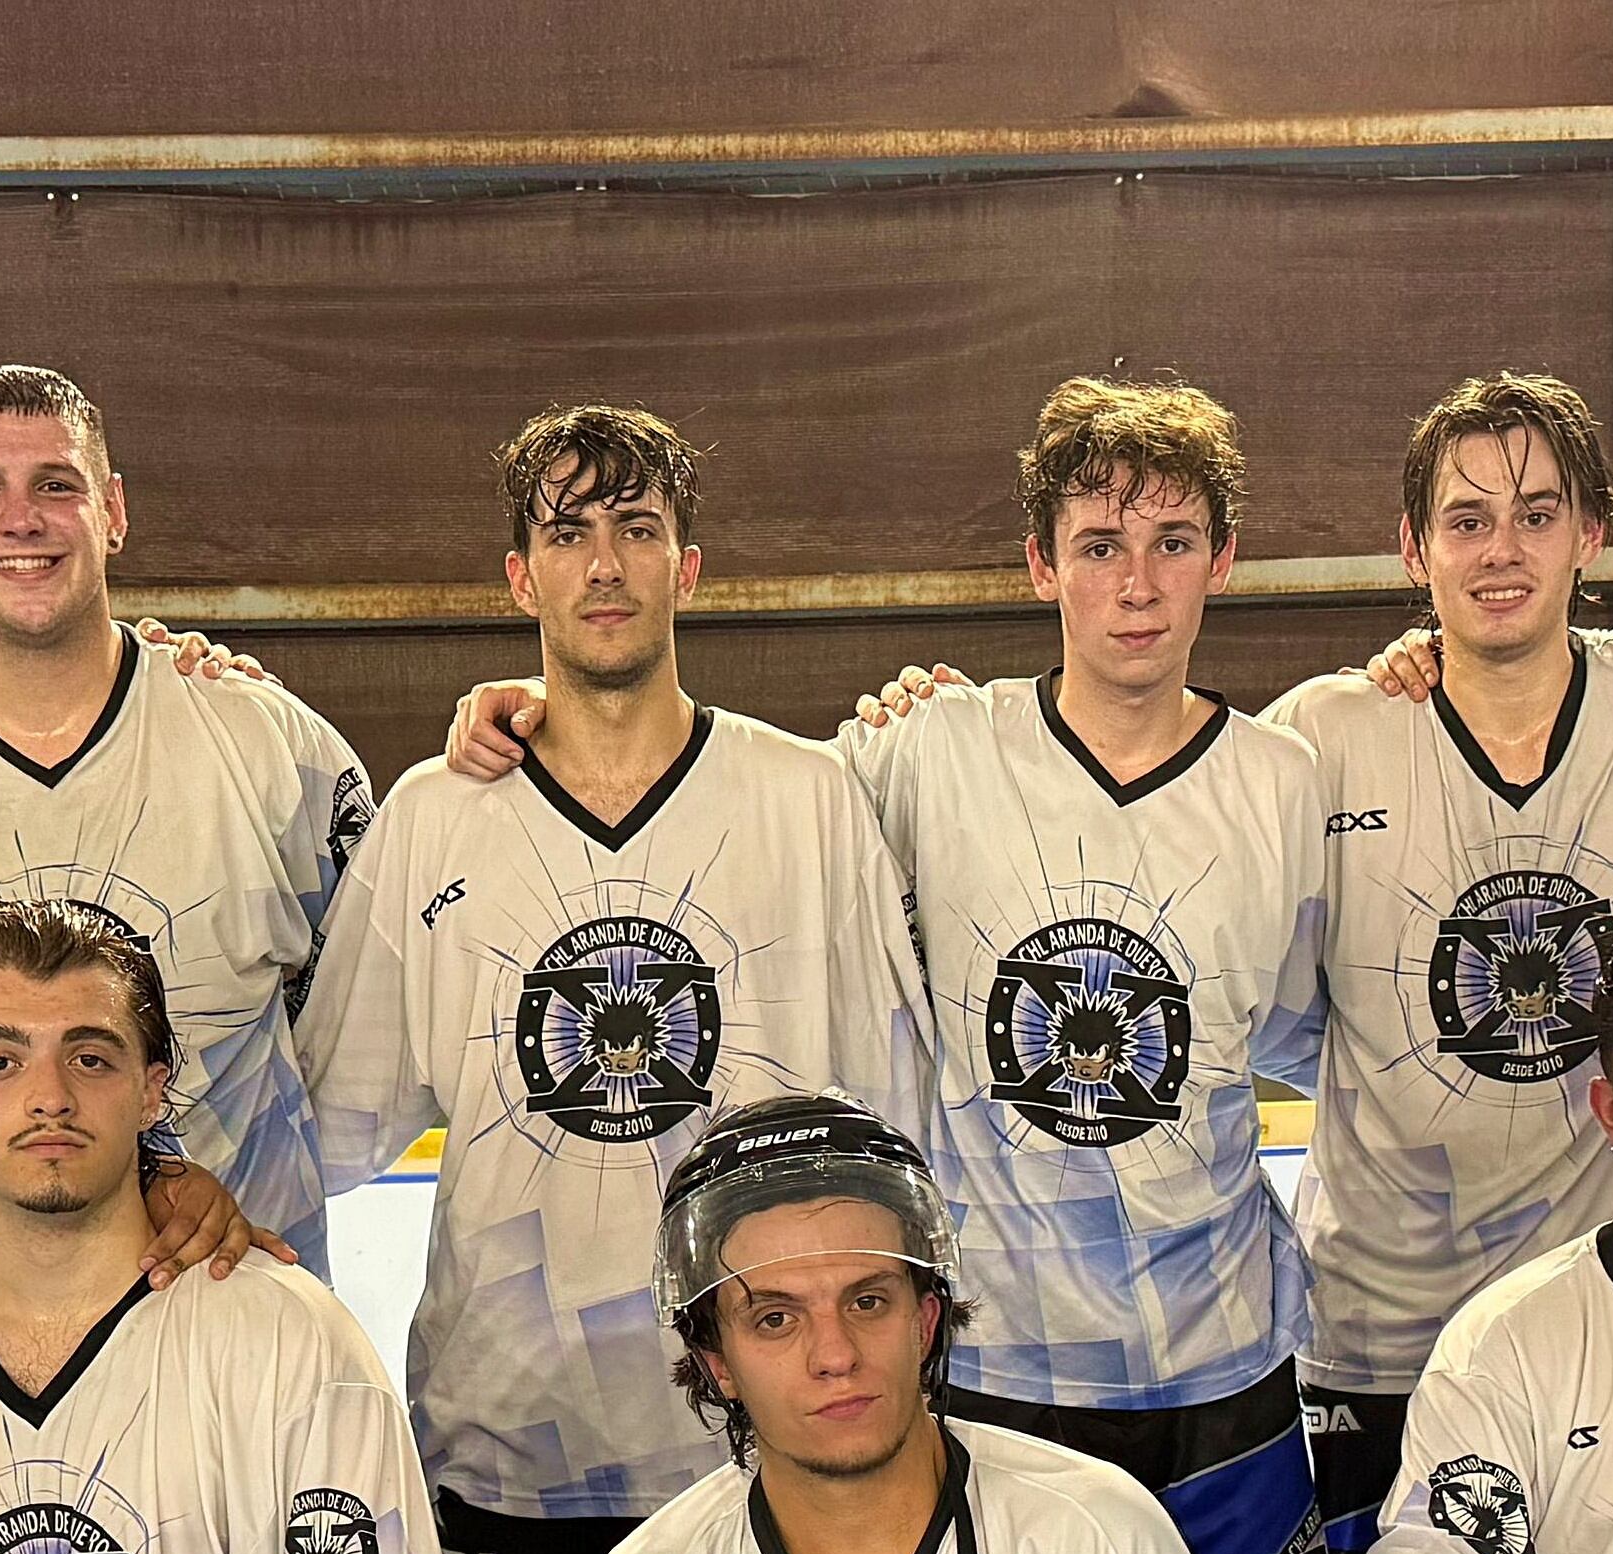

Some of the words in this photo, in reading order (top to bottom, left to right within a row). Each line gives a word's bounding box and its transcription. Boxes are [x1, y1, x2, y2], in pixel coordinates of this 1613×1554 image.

[1474, 878, 1525, 907] ARANDA
[1529, 876, 1545, 896] DE
[545, 944, 573, 969] CHL
[571, 922, 626, 953] ARANDA
[629, 923, 647, 943] DE
[649, 928, 694, 963] DUERO
[1019, 937, 1047, 961] CHL
[1050, 925, 1106, 951] ARANDA
[1108, 931, 1124, 951] DE
[1124, 937, 1169, 979] DUERO
[1501, 1061, 1534, 1077] DESDE
[1535, 1054, 1564, 1076] 2010
[590, 1118, 623, 1137] DESDE
[624, 1115, 654, 1135] 2010
[1055, 1120, 1085, 1140] DESDE
[327, 1492, 342, 1509] DE
[54, 1511, 70, 1533] DE
[70, 1517, 110, 1553] UERO
